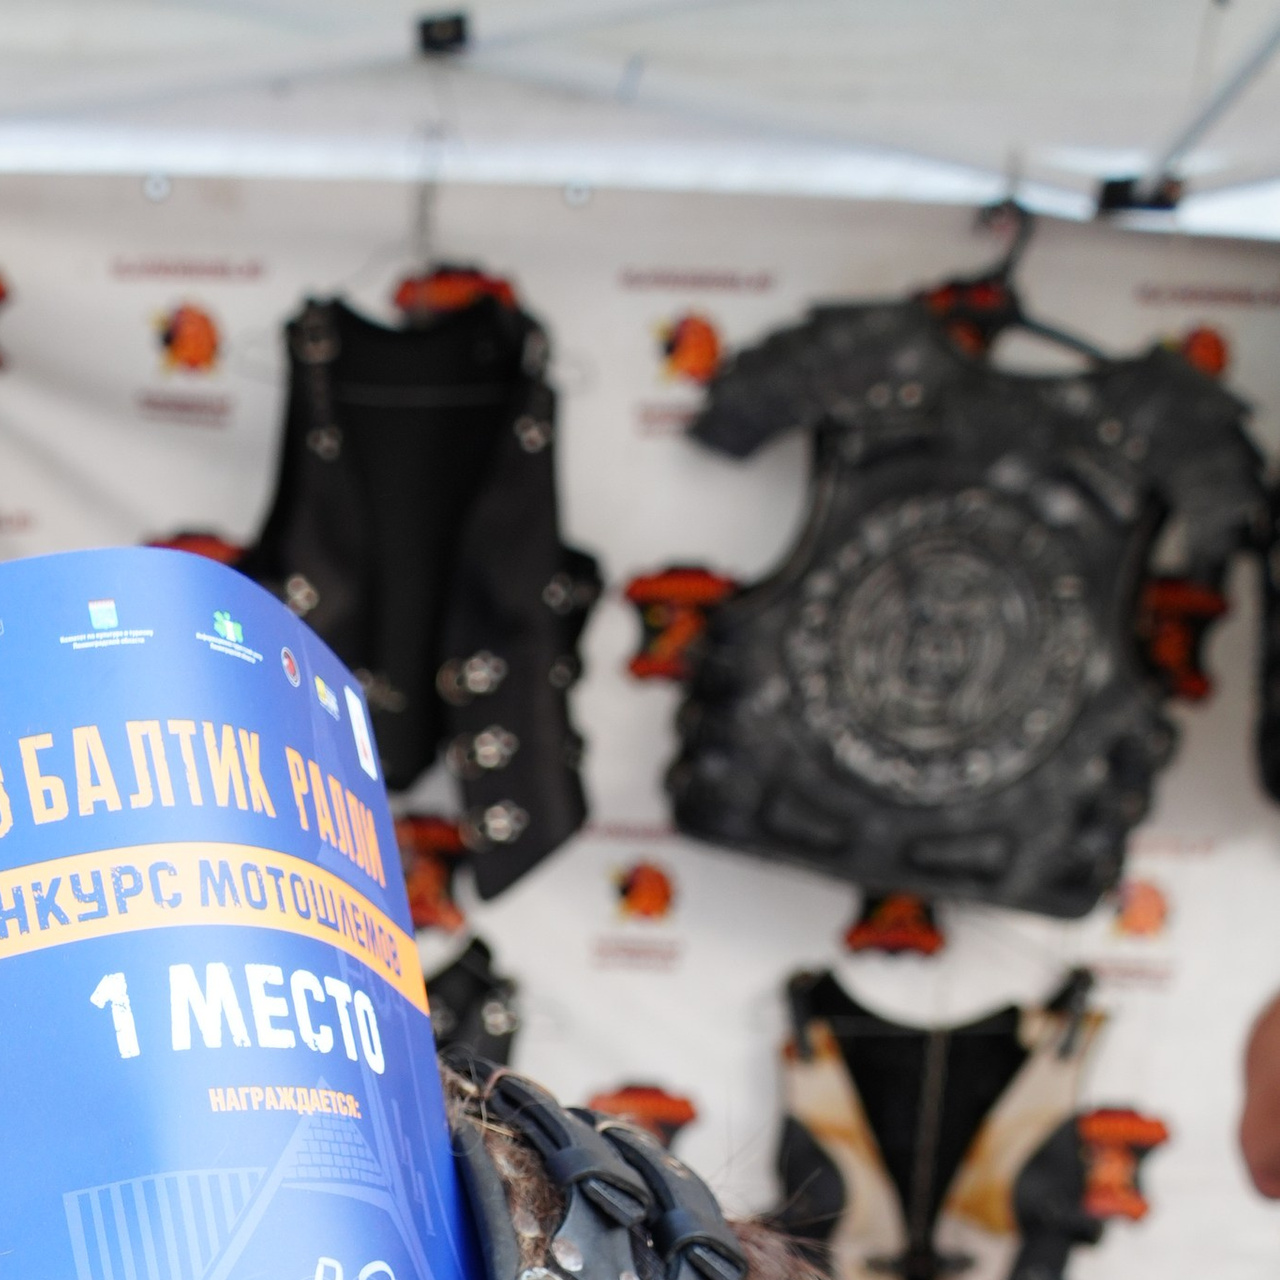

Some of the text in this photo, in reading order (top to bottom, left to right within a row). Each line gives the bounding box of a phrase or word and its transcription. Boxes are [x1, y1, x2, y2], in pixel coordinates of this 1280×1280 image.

[18, 718, 277, 825] БАЛТИК
[284, 745, 387, 889] РАЛЛИ
[198, 859, 402, 977] МОТОШЛЕМОВ
[89, 961, 386, 1075] 1 МЕСТО
[208, 1086, 362, 1119] НАГРАЖДАЕТСЯ:
